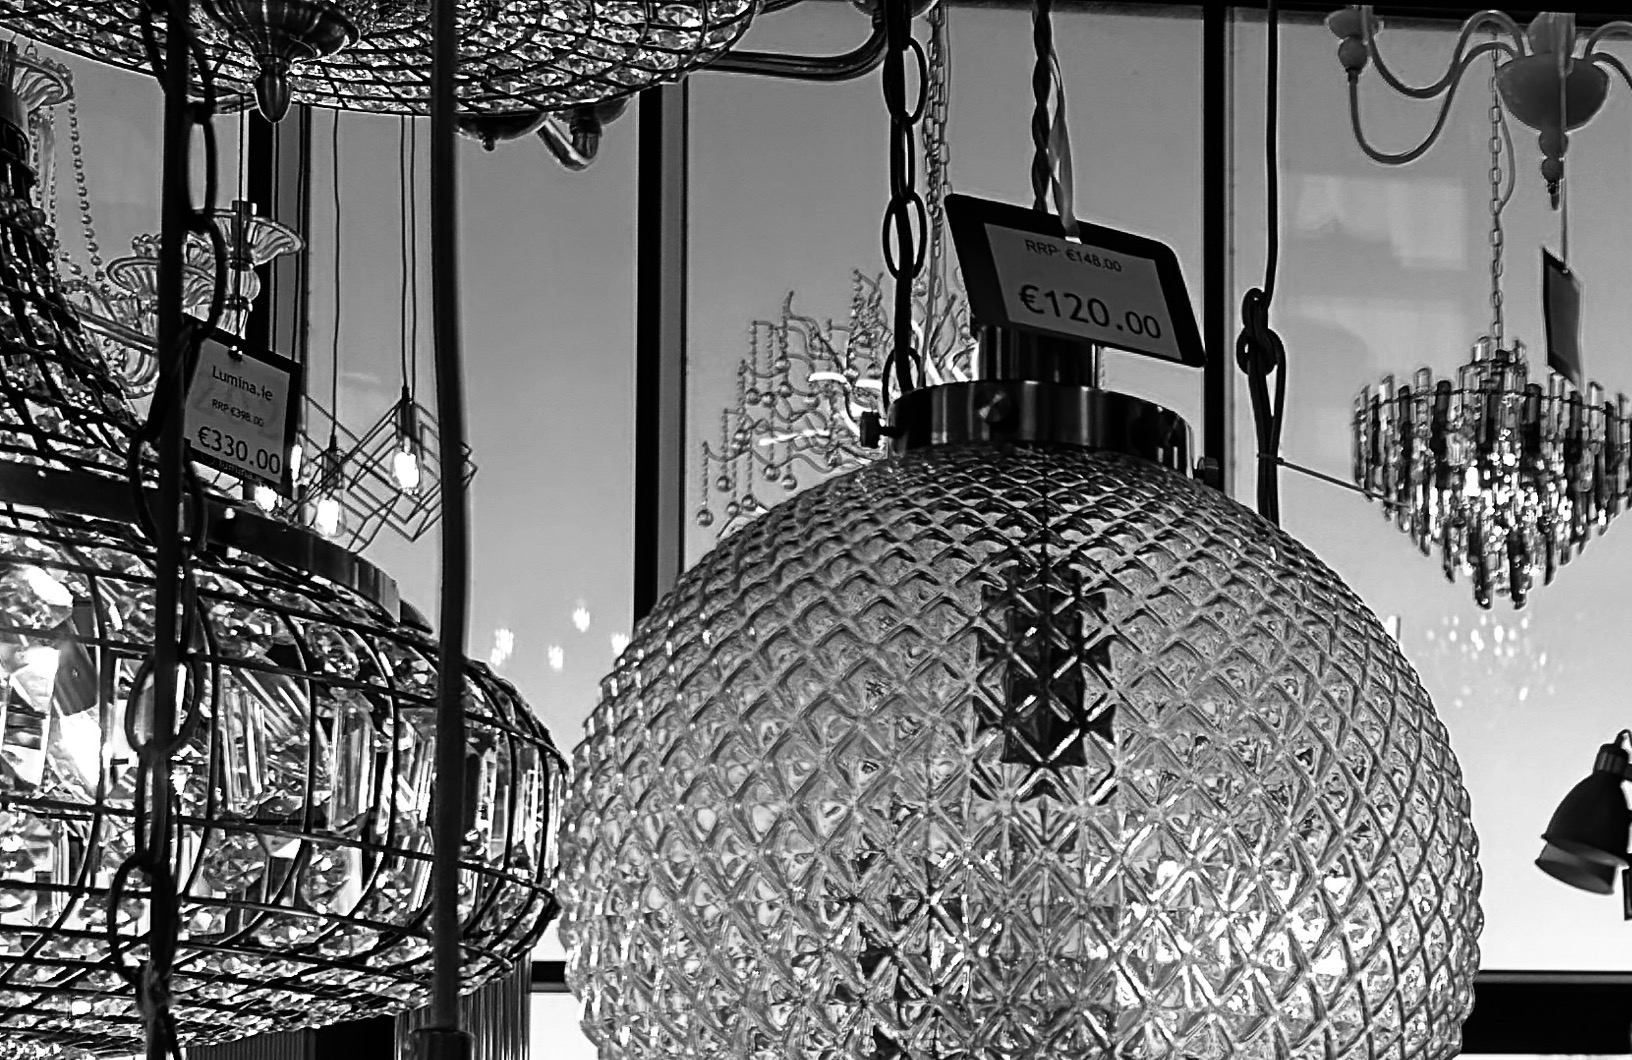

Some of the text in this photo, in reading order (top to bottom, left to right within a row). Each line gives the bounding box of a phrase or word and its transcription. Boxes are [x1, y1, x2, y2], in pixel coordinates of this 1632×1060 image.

[1067, 248, 1122, 273] €148.00
[1018, 284, 1161, 339] €120.00
[211, 365, 274, 402] Lumina.ie
[198, 426, 281, 474] €330.00
